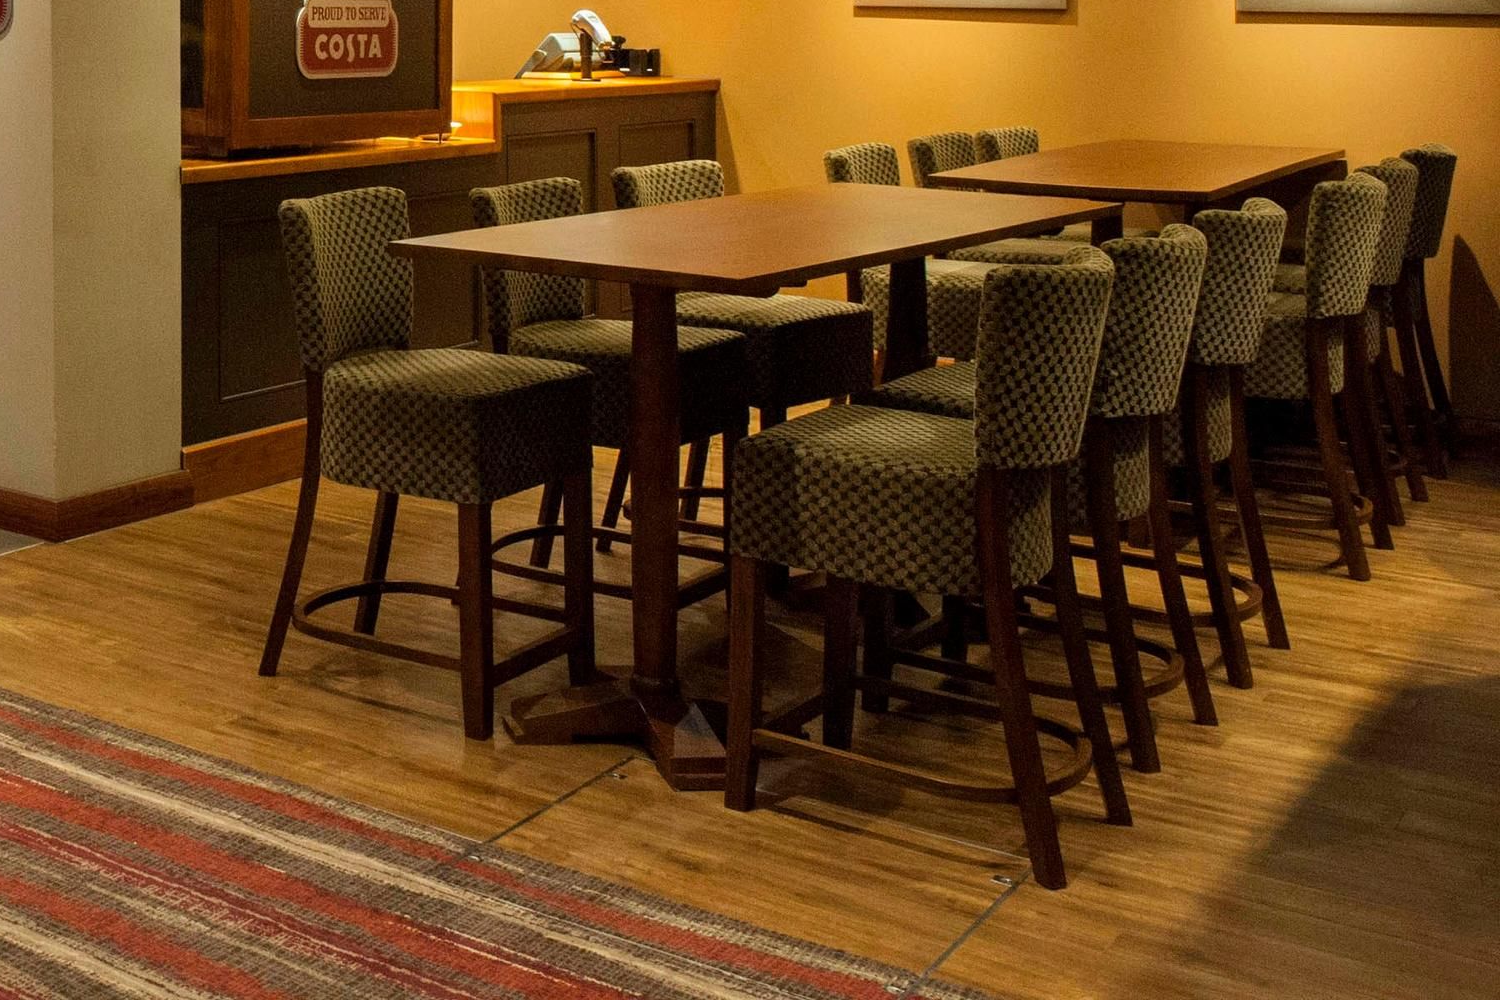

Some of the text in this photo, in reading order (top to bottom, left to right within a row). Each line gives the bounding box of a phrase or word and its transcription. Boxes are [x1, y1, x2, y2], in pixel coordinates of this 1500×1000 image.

[311, 5, 386, 21] PROUD TO SERVE
[314, 33, 382, 63] COSTA
